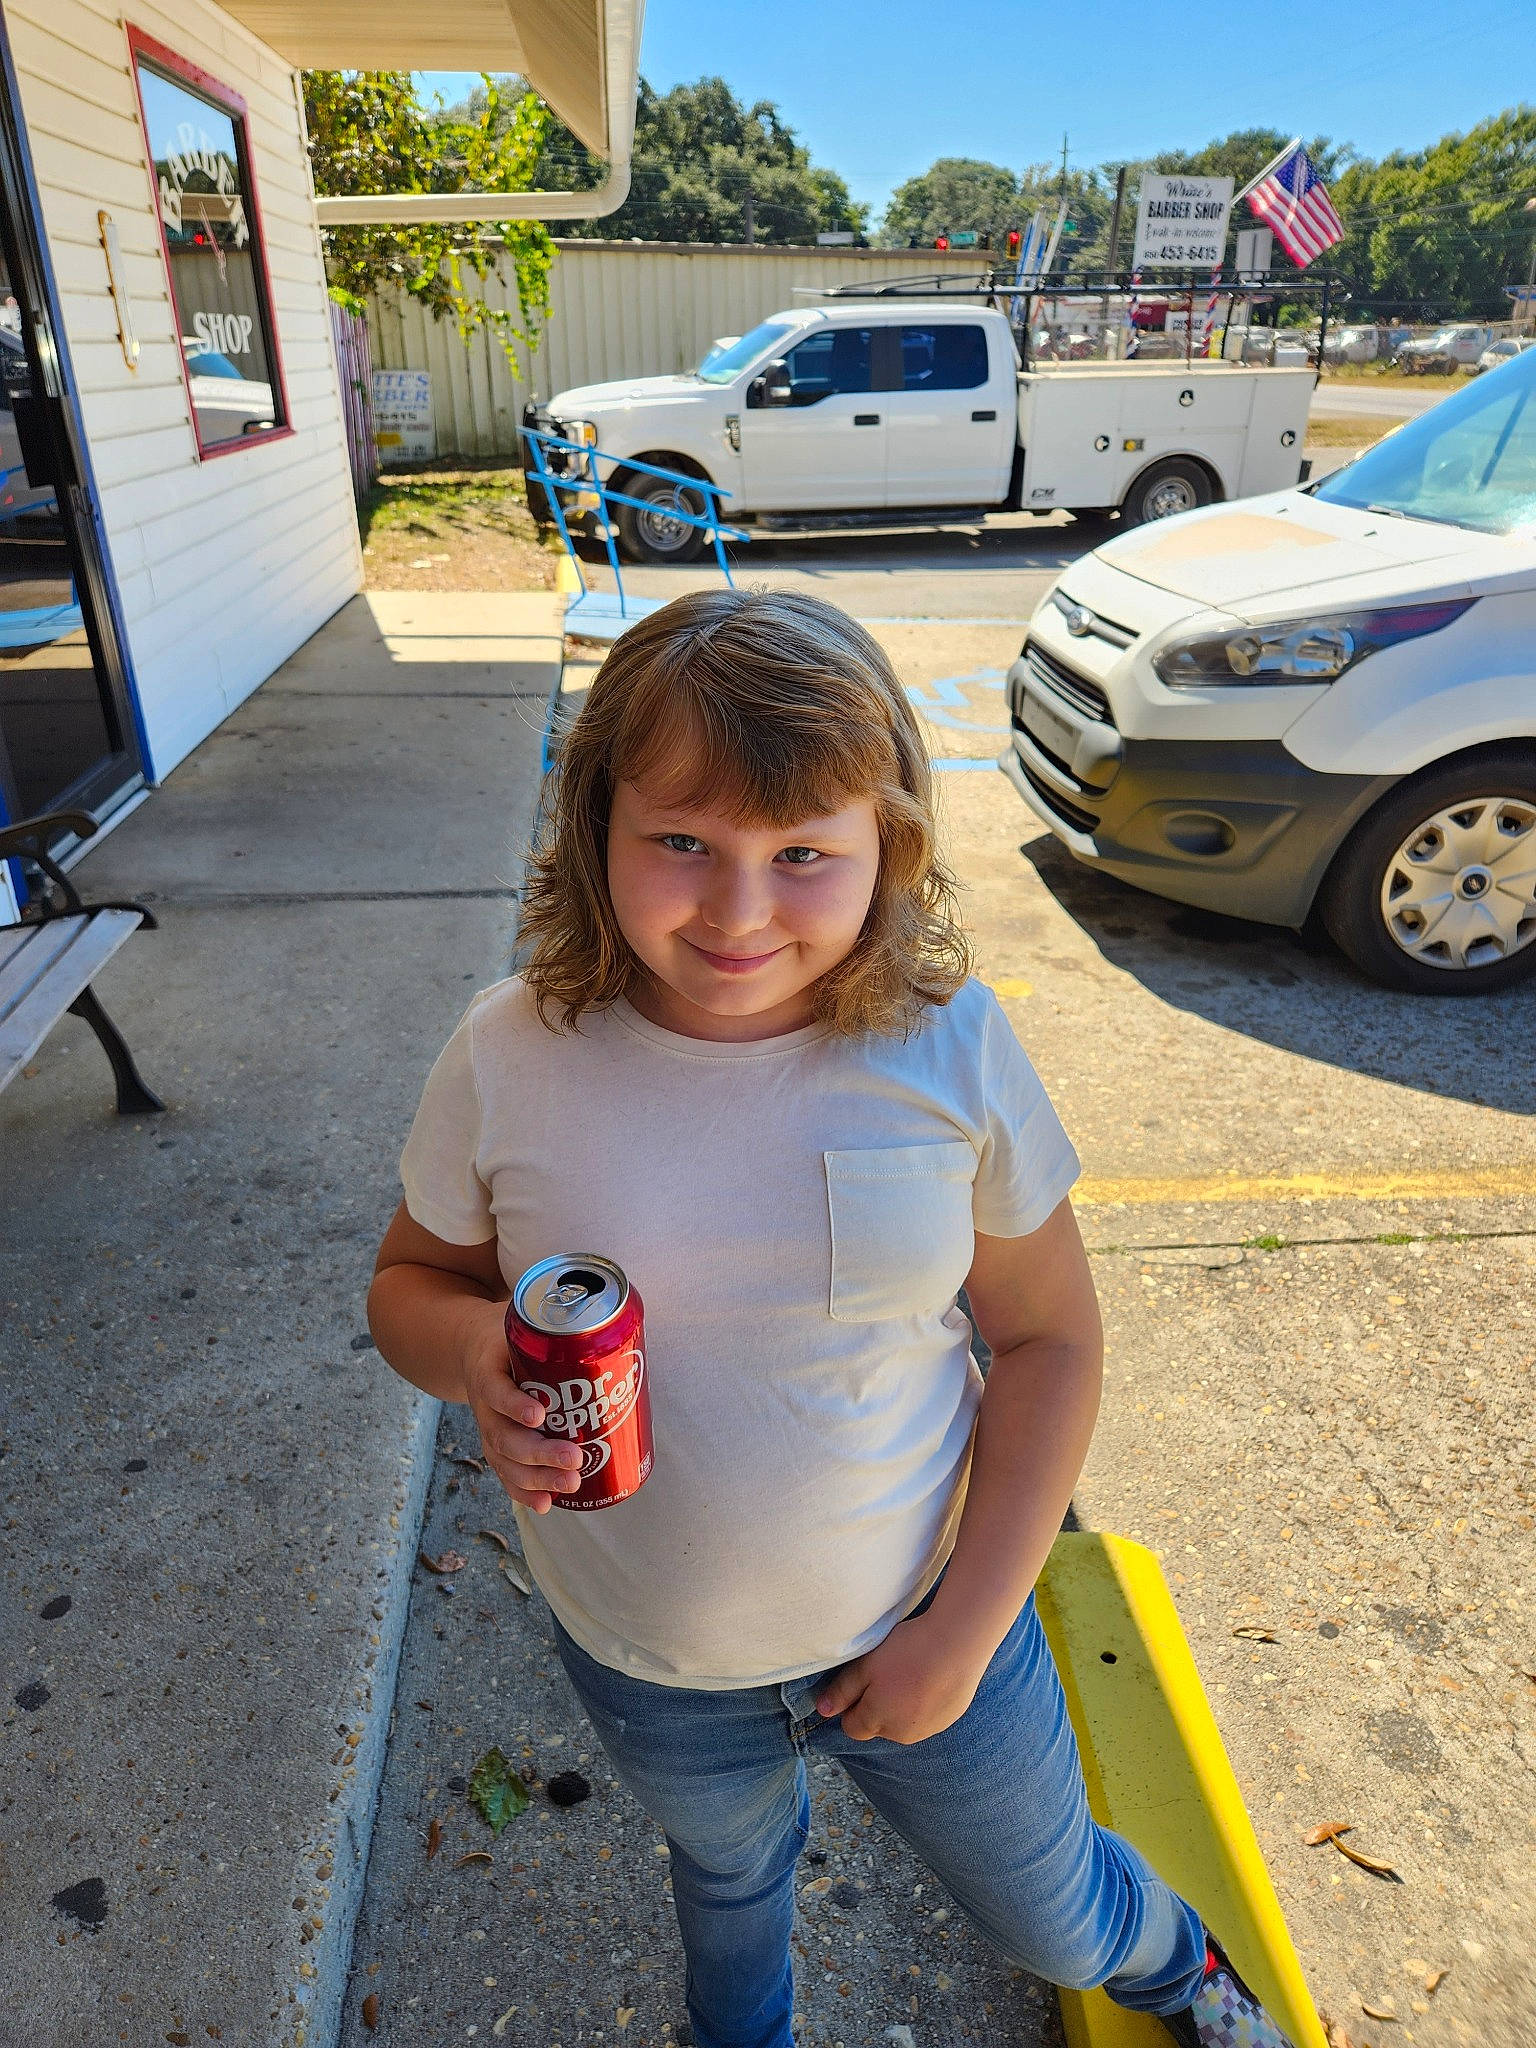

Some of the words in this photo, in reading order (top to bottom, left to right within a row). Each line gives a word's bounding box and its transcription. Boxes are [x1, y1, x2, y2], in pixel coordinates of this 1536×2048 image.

[1165, 181, 1213, 198] White's
[1148, 201, 1191, 219] BARBER
[1195, 203, 1224, 219] SHOP
[193, 311, 252, 354] SHOP
[559, 1371, 613, 1411] Dr
[560, 1499, 571, 1507] 12
[582, 1500, 594, 1508] OZ
[595, 1496, 613, 1507] (355
